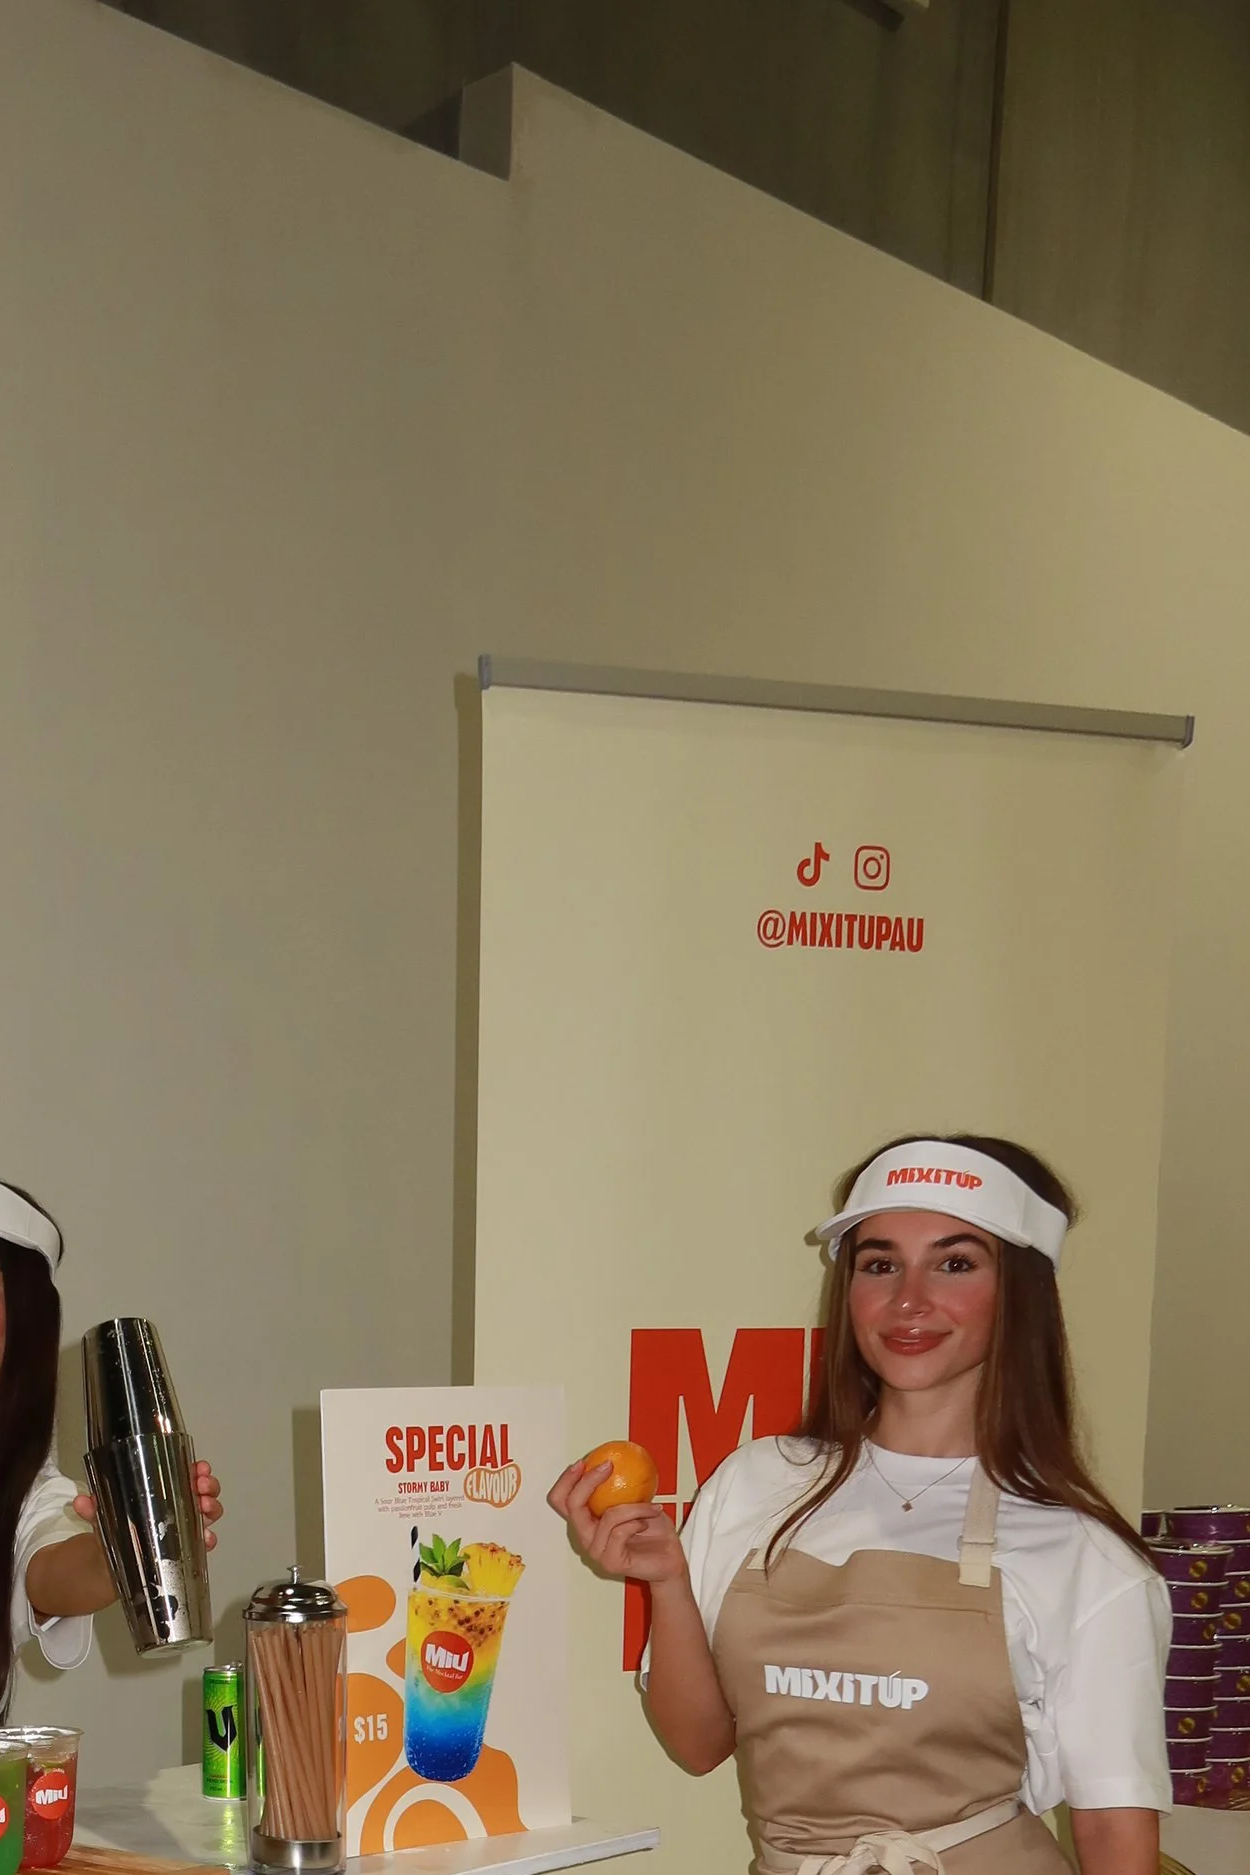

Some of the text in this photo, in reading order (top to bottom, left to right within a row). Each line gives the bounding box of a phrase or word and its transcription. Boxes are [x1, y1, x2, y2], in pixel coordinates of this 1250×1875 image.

[757, 909, 924, 953] @MIXITUPAU
[385, 1424, 514, 1473] SPECIAL
[398, 1480, 450, 1494] STORMY BABY
[466, 1465, 518, 1504] FLAVOUR
[353, 1713, 388, 1745] $15
